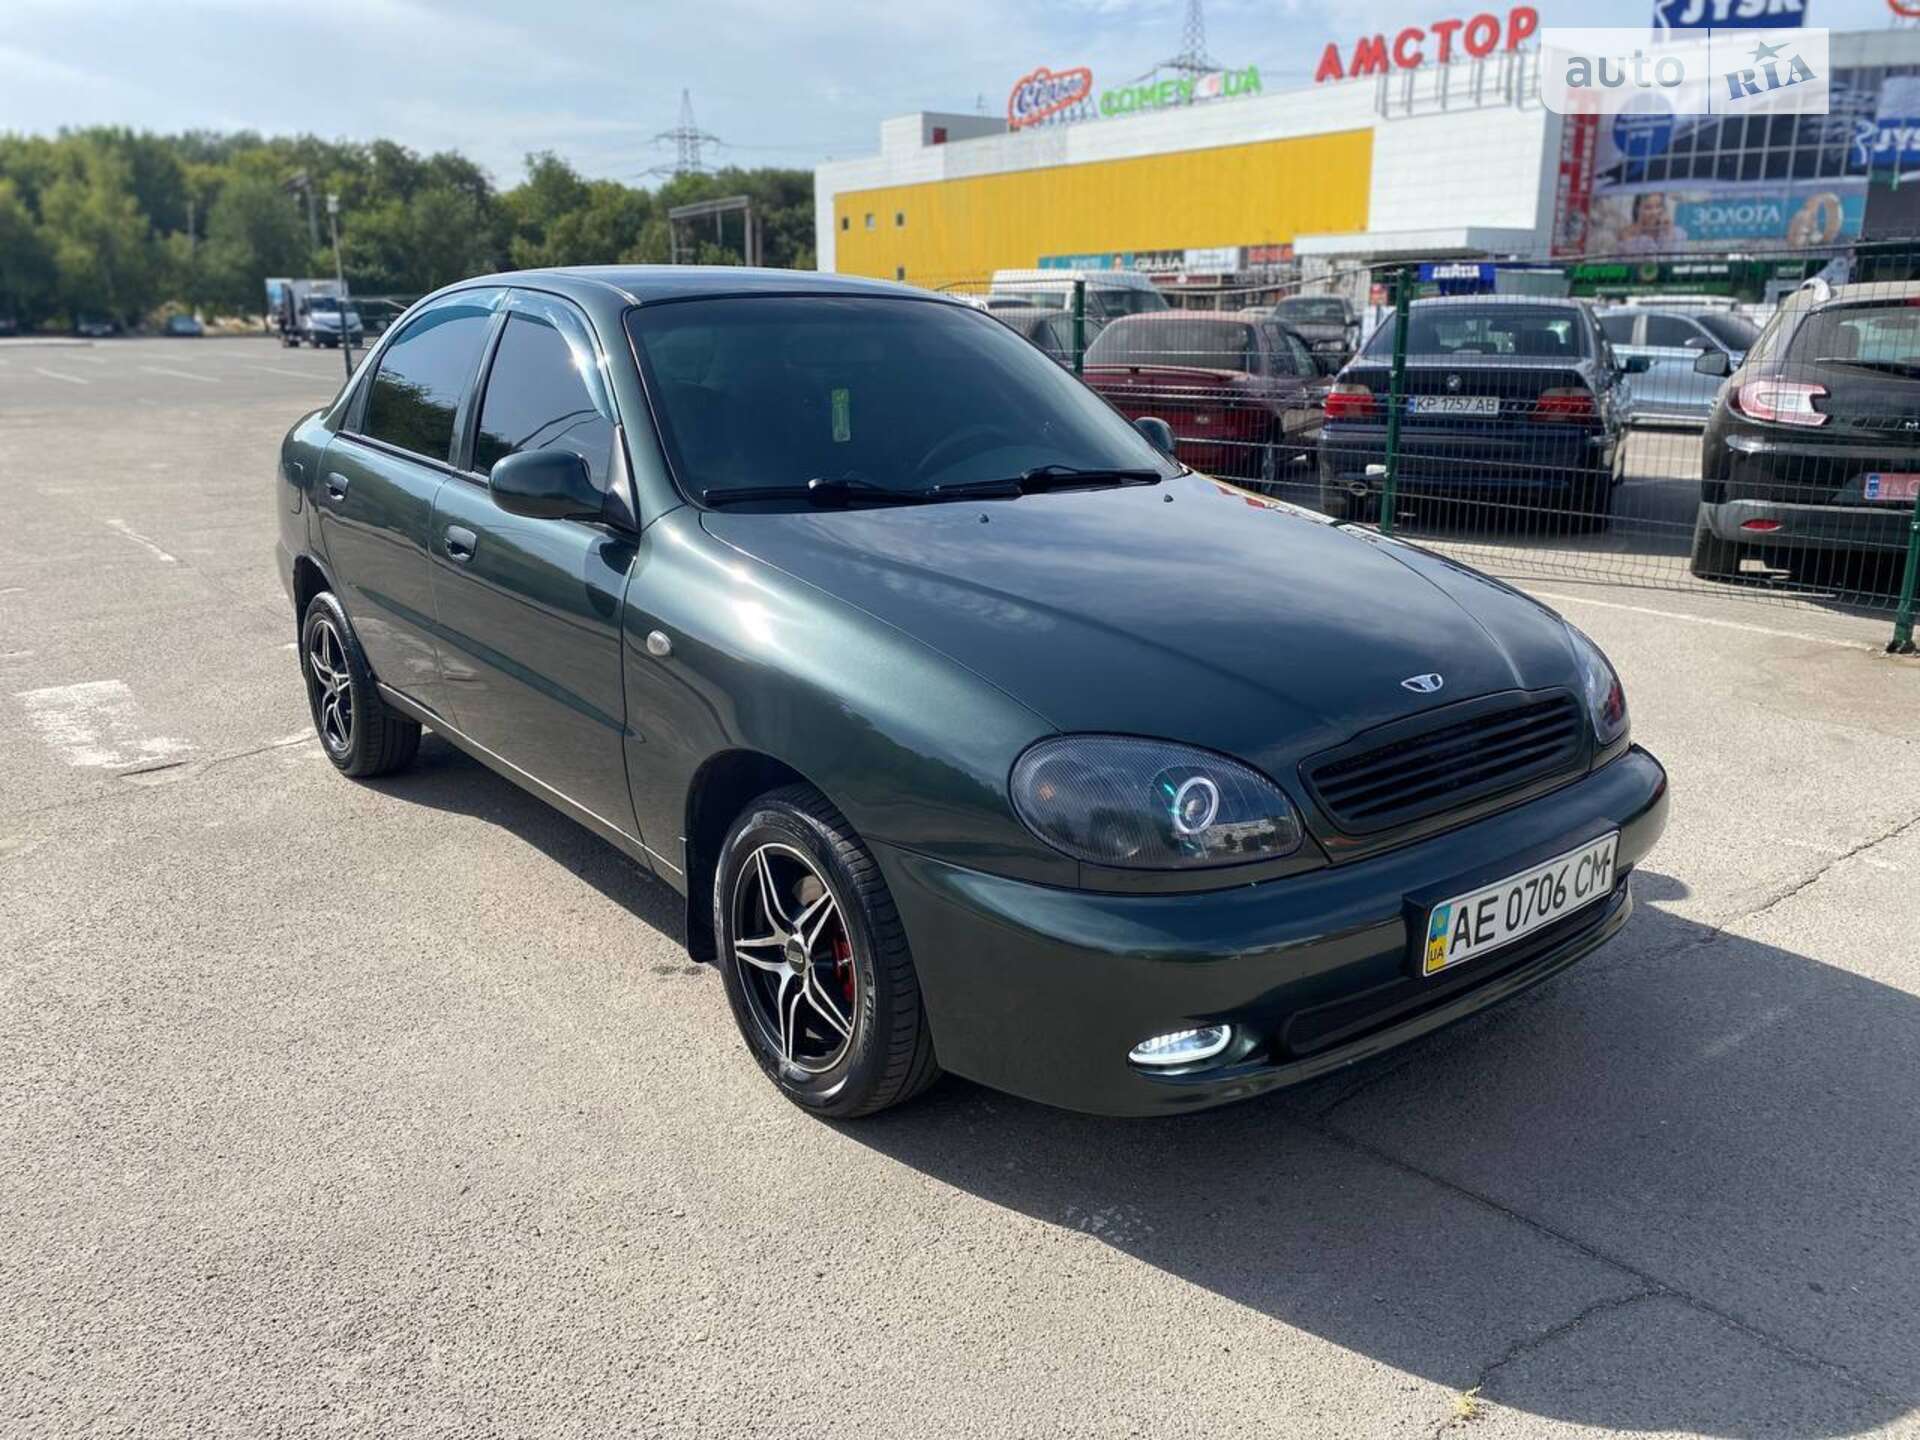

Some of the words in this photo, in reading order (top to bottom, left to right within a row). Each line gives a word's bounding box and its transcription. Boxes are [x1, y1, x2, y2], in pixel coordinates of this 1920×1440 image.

[1315, 6, 1538, 82] АМСТОР
[1442, 398, 1472, 411] 1757
[1449, 896, 1499, 955] AE
[1505, 864, 1570, 932] 0706
[1575, 844, 1611, 898] CM
[1429, 949, 1444, 962] UA
